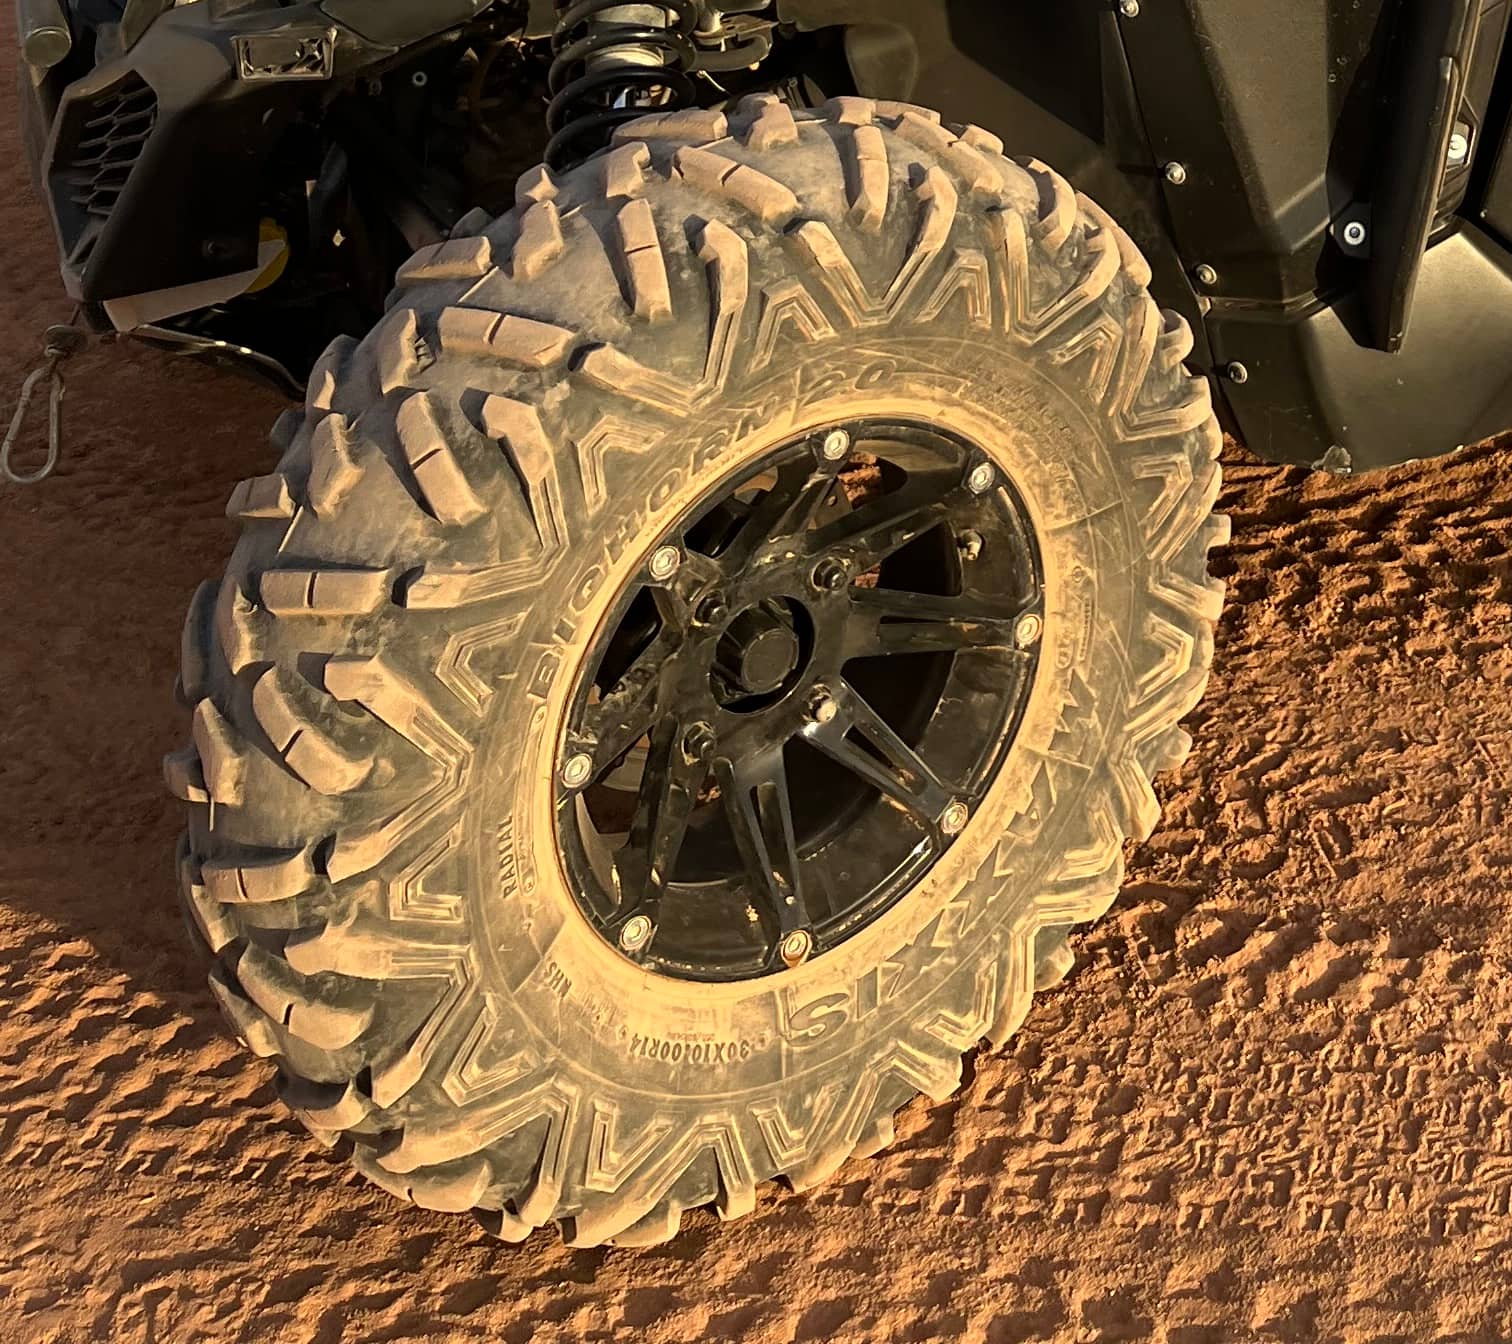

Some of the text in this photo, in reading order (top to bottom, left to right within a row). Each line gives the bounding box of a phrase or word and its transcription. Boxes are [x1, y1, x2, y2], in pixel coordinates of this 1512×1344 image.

[498, 815, 518, 899] RADIAL
[786, 666, 1099, 1049] MAXXIS
[548, 961, 572, 999] NHS
